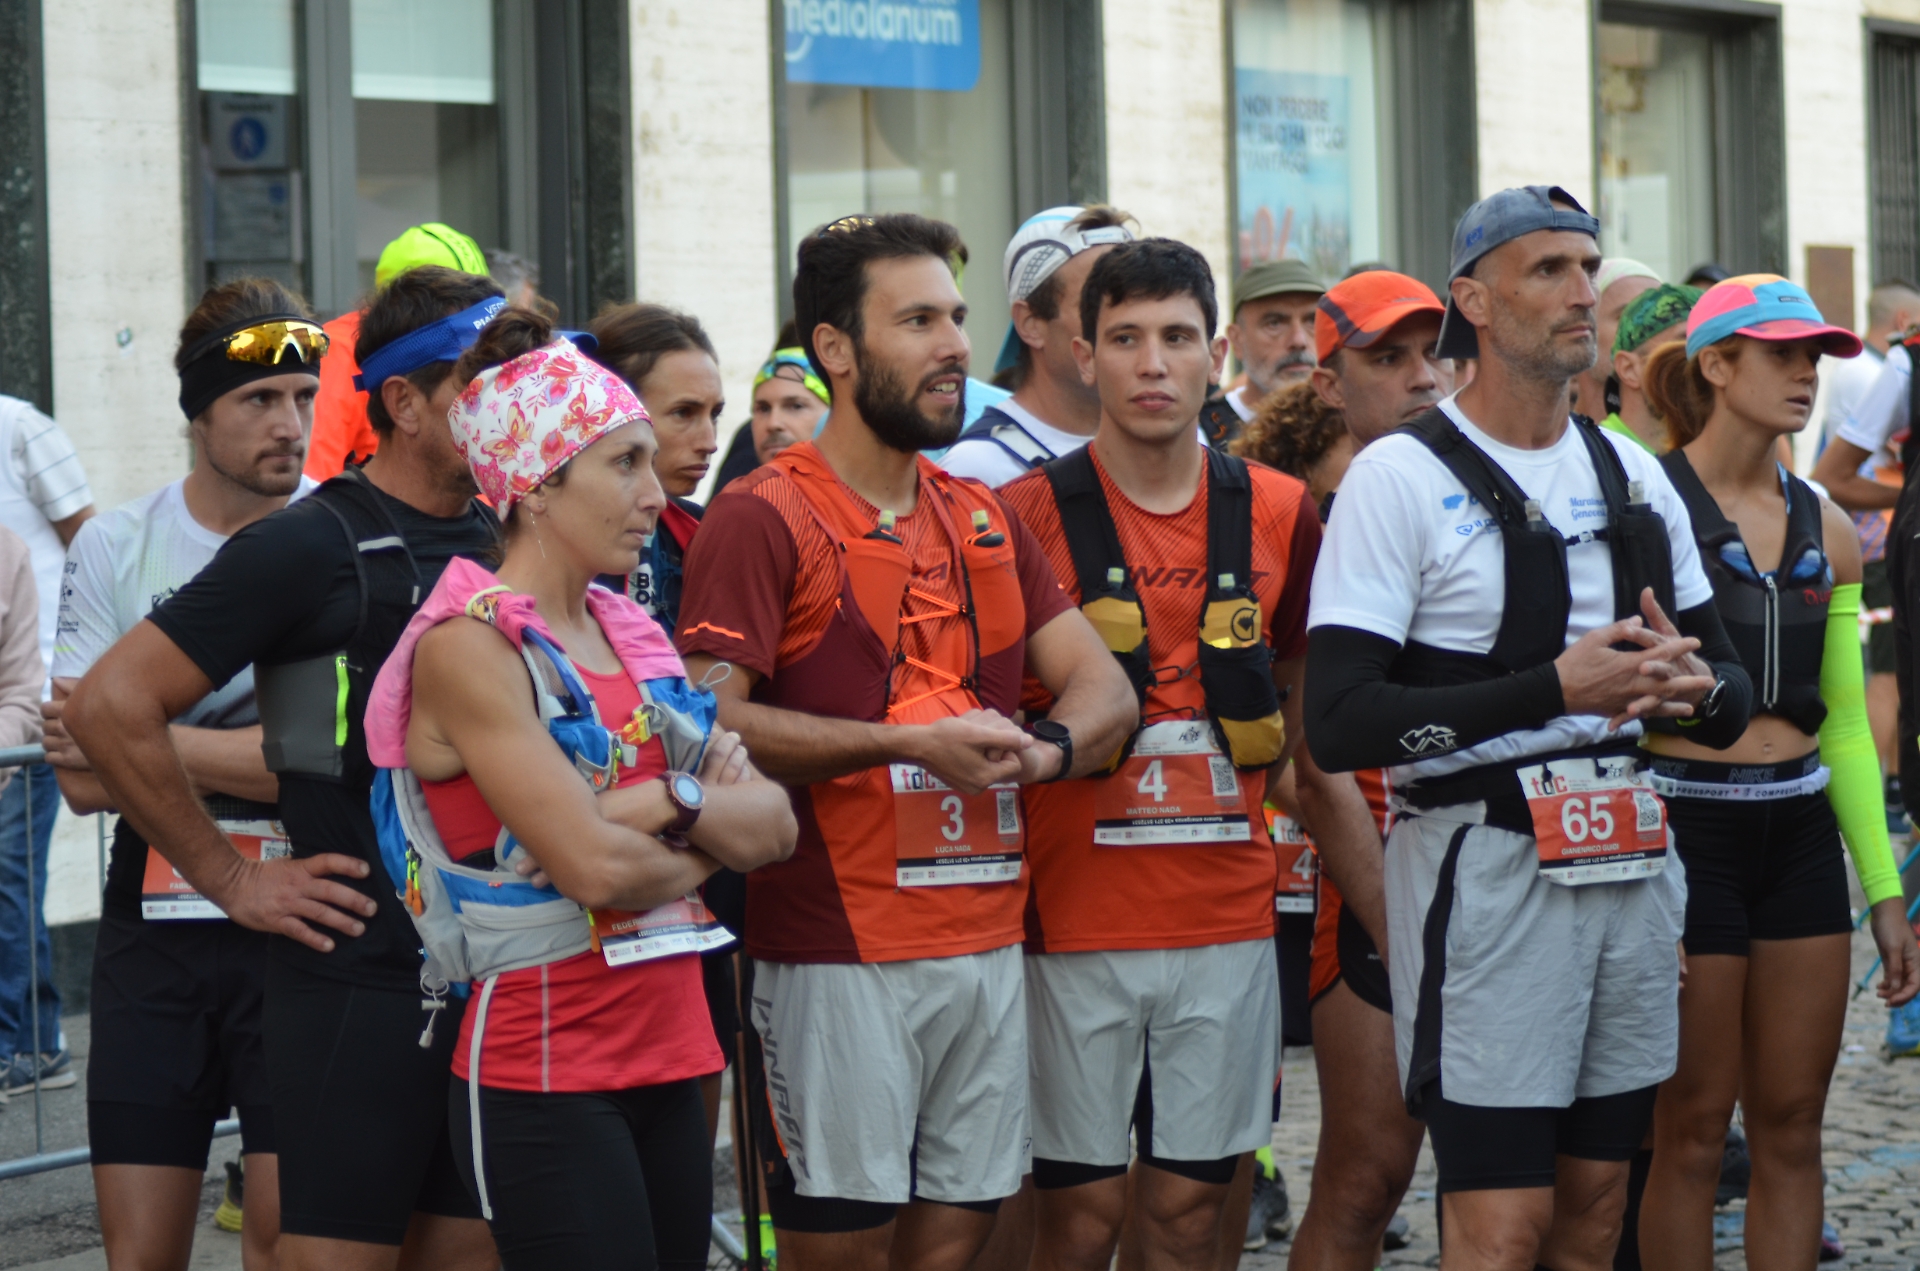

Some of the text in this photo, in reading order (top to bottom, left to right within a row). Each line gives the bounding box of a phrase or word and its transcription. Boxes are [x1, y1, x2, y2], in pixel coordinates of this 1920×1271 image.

[1137, 759, 1168, 802] 4
[1728, 767, 1776, 783] NIKE
[940, 795, 964, 842] 3
[1126, 806, 1181, 815] MATTEO NADA
[1561, 796, 1615, 843] 65
[935, 845, 953, 853] LUCA
[1561, 843, 1620, 855] GIANENRICO GUIDI
[1292, 848, 1312, 881] 4
